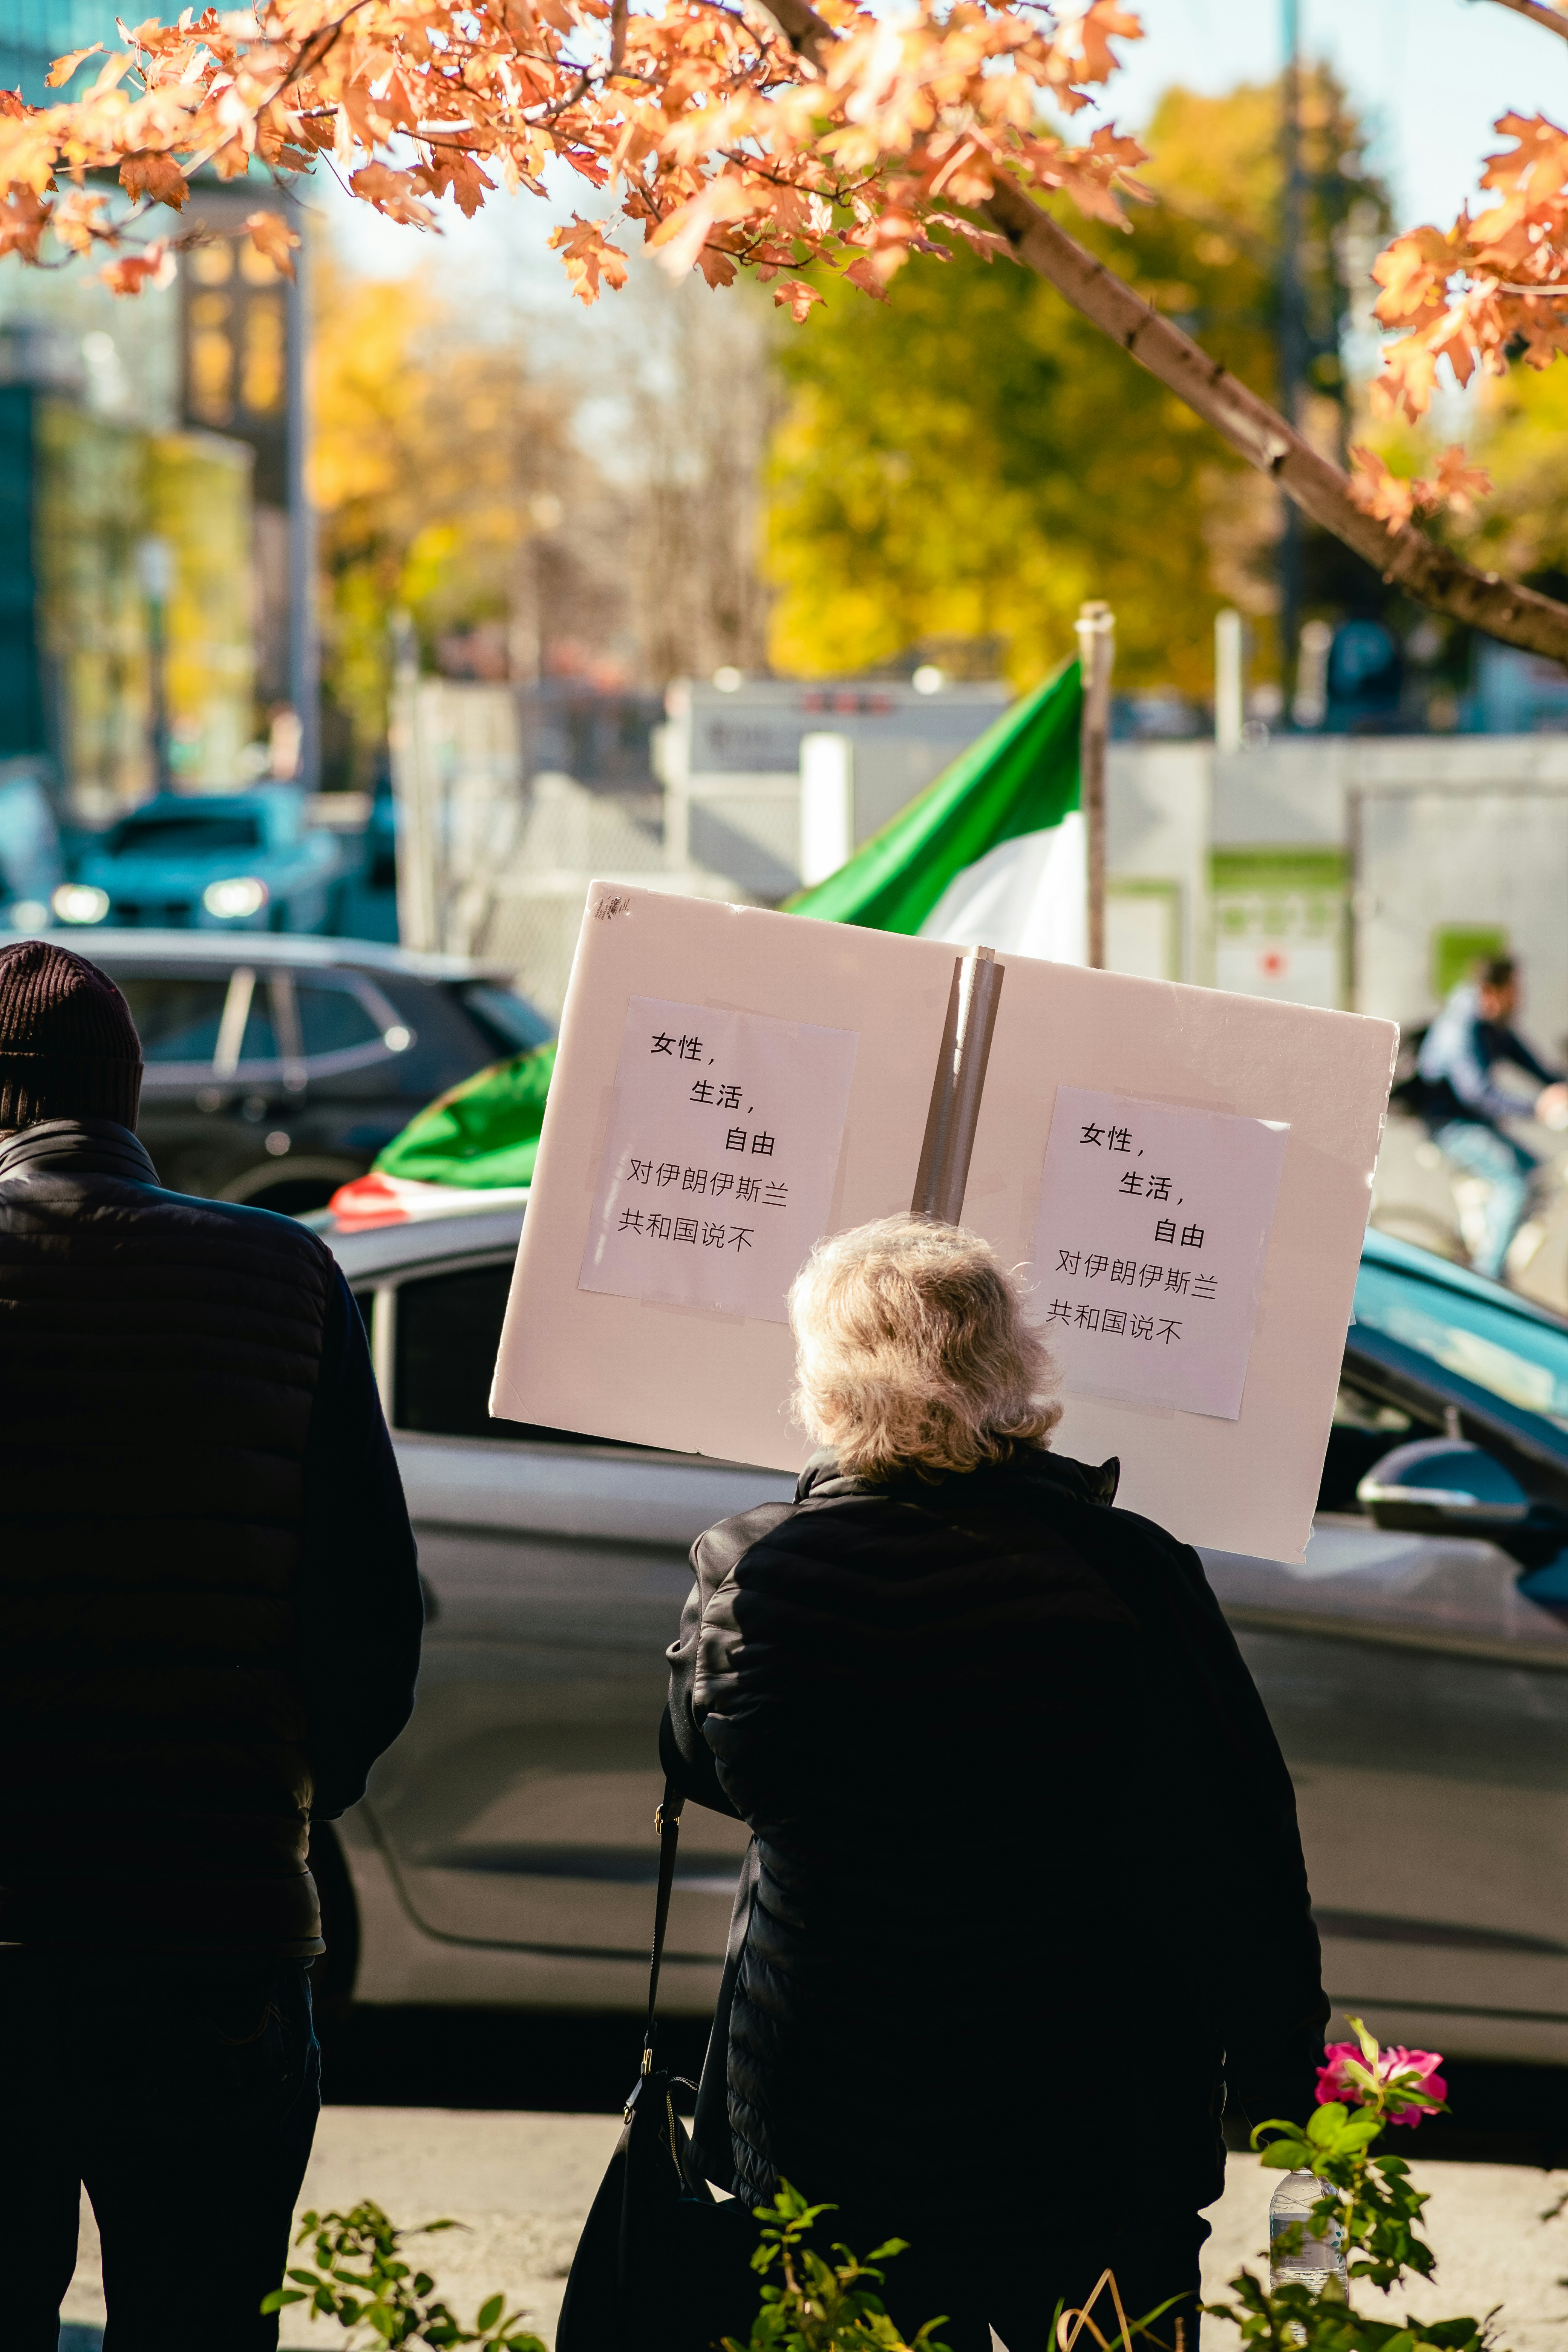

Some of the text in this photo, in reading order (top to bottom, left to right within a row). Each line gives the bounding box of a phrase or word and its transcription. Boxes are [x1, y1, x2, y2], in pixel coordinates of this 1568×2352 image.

[725, 1127, 775, 1156] 自由
[627, 1159, 788, 1207] 对伊朗伊斯兰
[618, 1208, 754, 1252] 共和国说不
[1154, 1218, 1205, 1248] 自由
[1055, 1250, 1217, 1300] 对伊朗伊斯兰
[1046, 1299, 1183, 1344] 共和国说不
